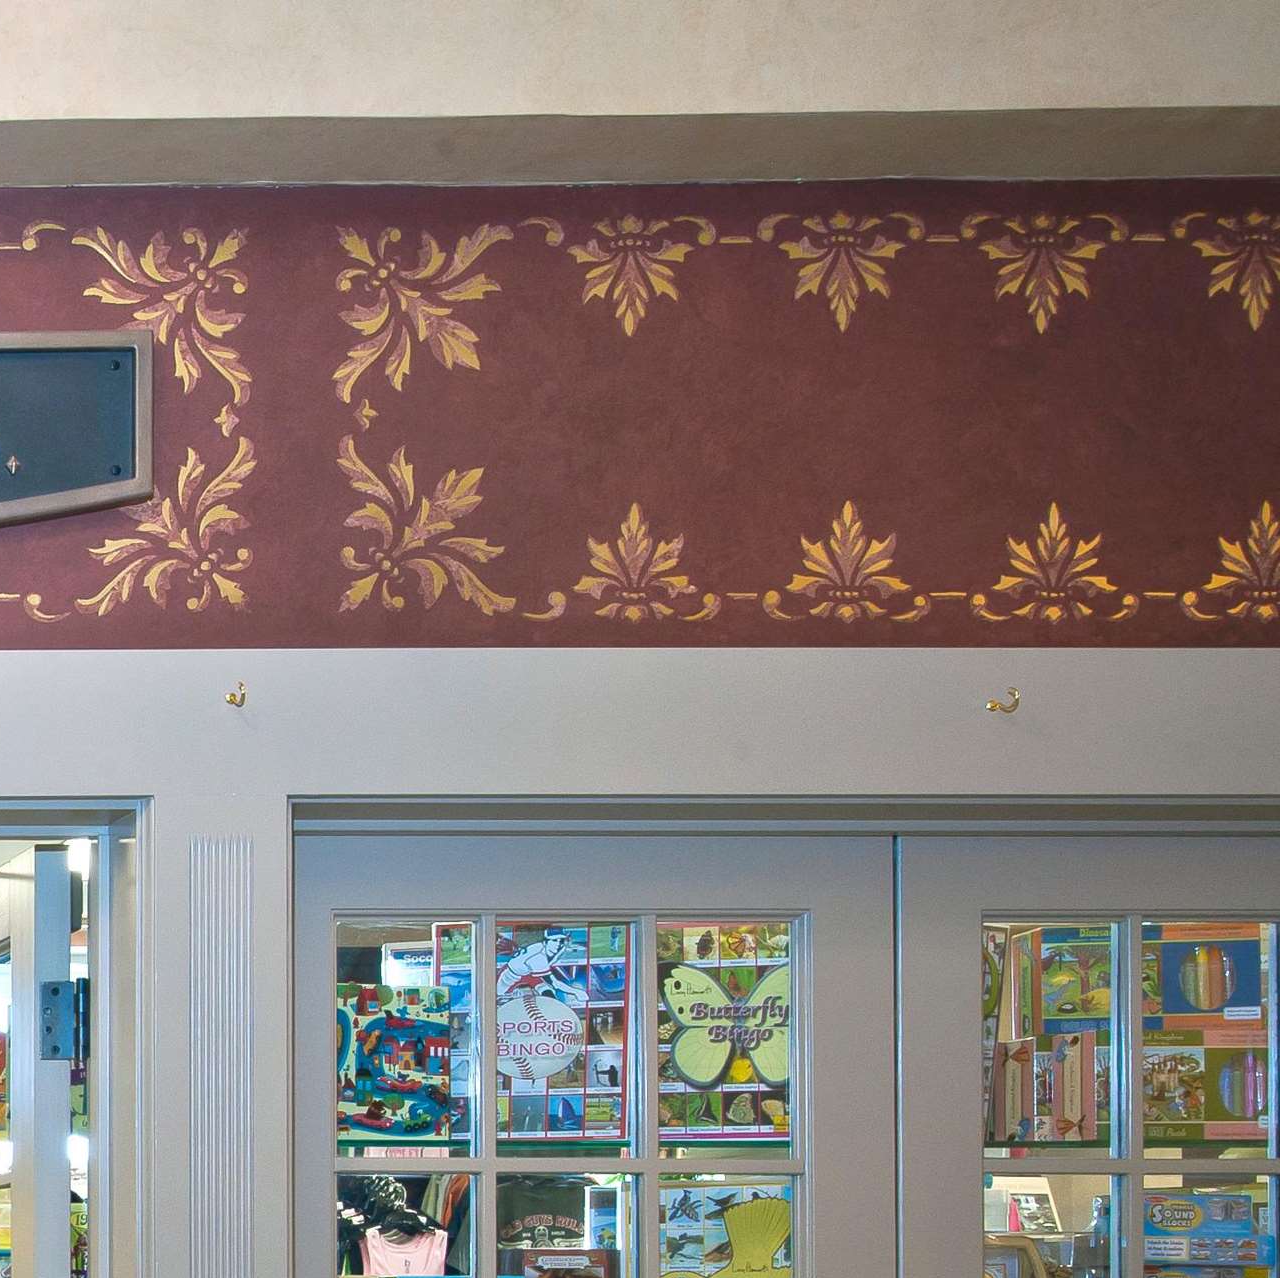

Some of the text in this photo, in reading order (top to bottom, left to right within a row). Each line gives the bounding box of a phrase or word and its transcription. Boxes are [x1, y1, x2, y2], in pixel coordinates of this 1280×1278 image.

[690, 996, 789, 1027] Butterfly
[497, 1020, 573, 1034] SPORTS
[708, 1025, 773, 1050] Bingo
[497, 1042, 565, 1056] BINGO
